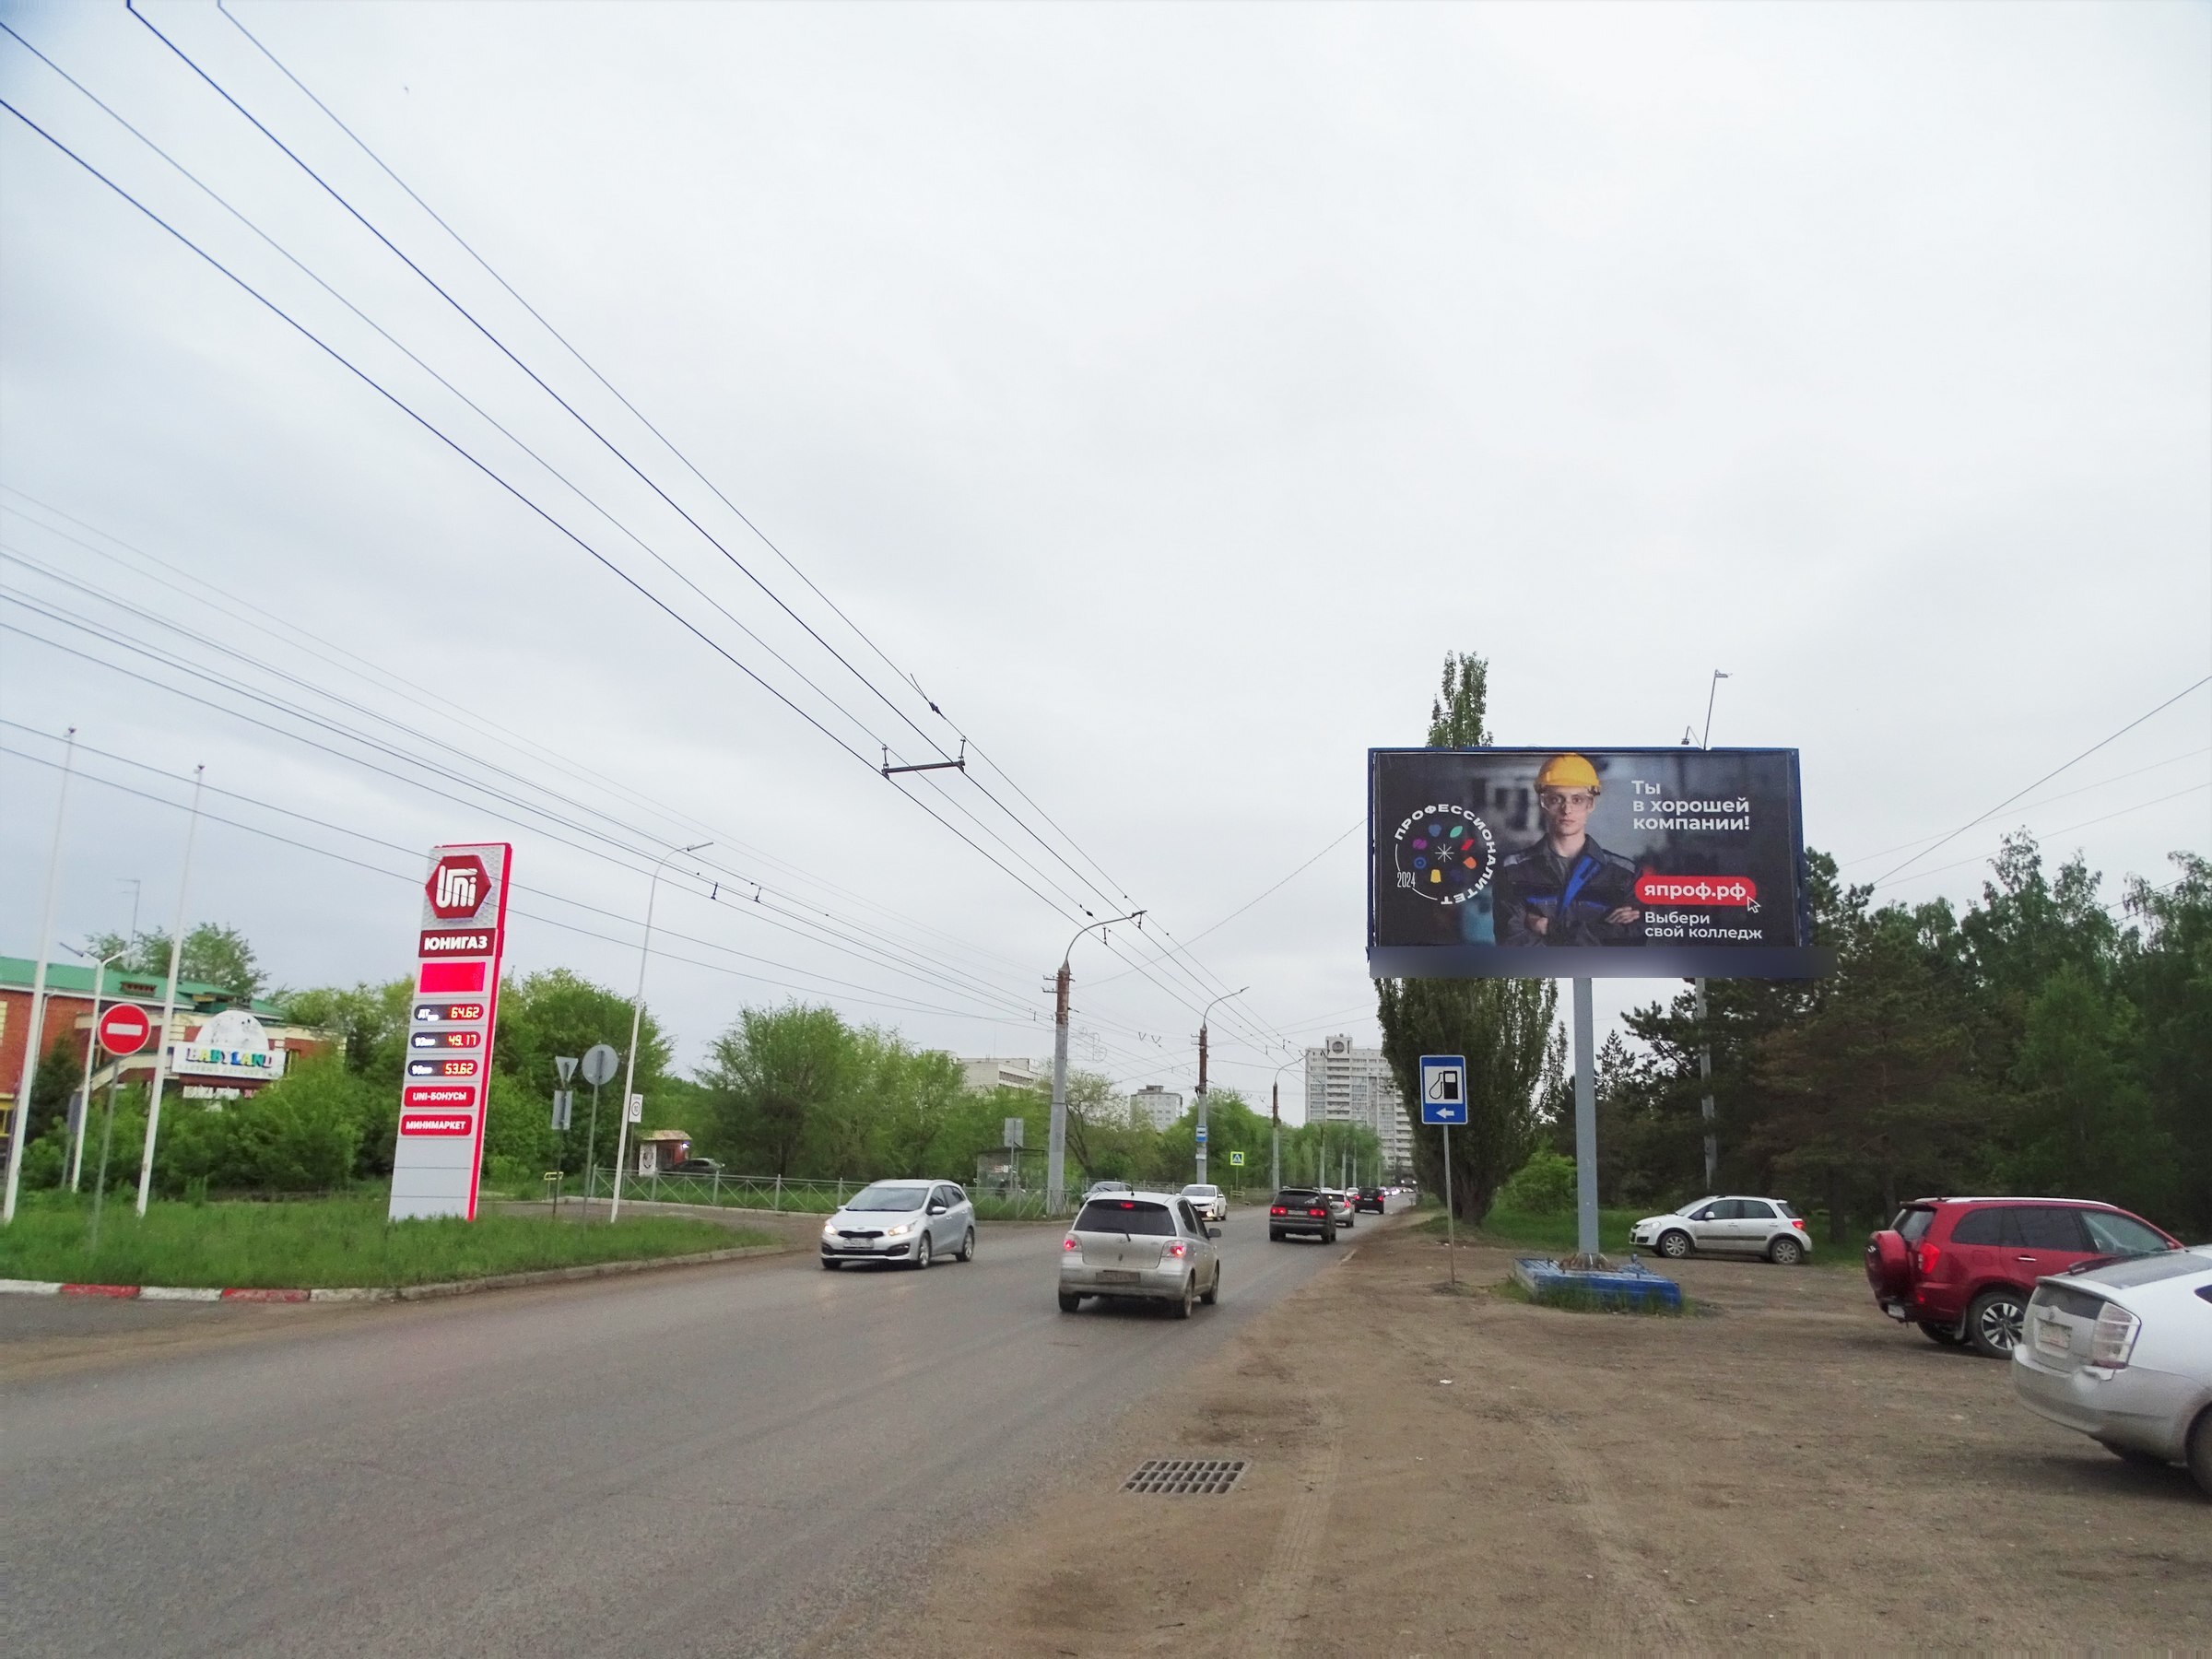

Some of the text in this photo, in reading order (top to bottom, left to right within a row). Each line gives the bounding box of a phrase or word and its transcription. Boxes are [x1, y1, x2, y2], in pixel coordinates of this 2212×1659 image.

[1631, 780, 1661, 794] Ты
[1632, 797, 1750, 816] в хорошей
[1633, 816, 1750, 830] компании!
[1394, 803, 1498, 905] ПРОФЕССИОНАЛИТЕТ
[1396, 871, 1417, 888] 2024
[1644, 882, 1747, 900] япроф.рф
[1644, 911, 1711, 926] Выбери
[1644, 925, 1762, 939] свой колледж
[424, 935, 488, 950] ЮНИГАЗ
[451, 1006, 480, 1018] 64.62
[448, 1034, 477, 1046] 49.17
[445, 1063, 474, 1075] 53.62
[413, 1091, 466, 1101] UNI-БОНУСЫ
[406, 1121, 466, 1130] МИНИМАРКЕТ
